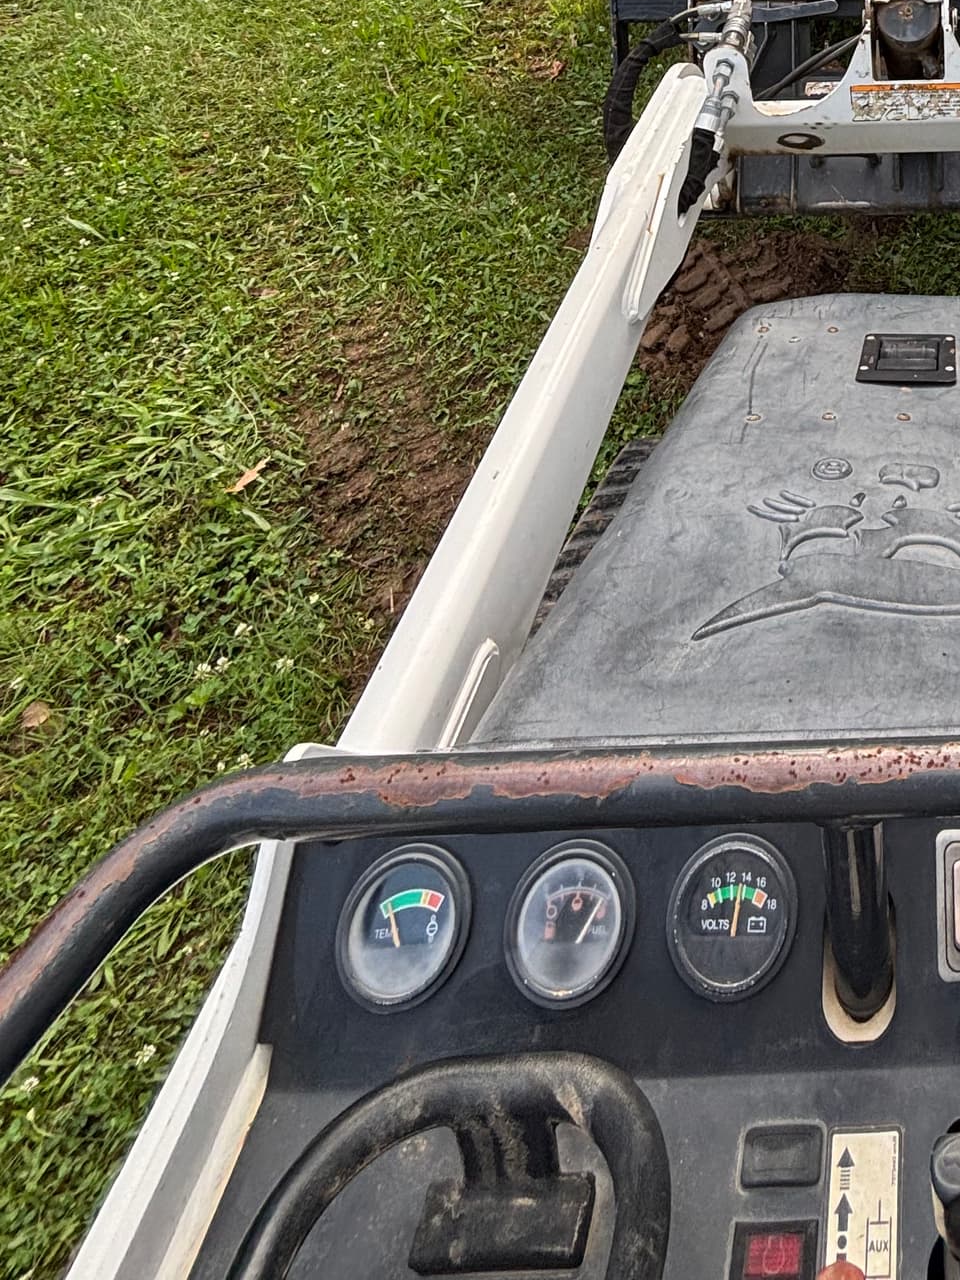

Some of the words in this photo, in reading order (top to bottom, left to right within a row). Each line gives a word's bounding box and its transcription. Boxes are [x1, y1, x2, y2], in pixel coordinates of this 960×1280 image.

[711, 876, 722, 888] 10
[726, 872, 736, 882] 12
[742, 872, 752, 882] 14
[756, 876, 766, 888] 16
[701, 899, 708, 910] 8
[767, 898, 776, 910] 18
[701, 919, 730, 930] VOLTS
[869, 1240, 888, 1252] AUX
